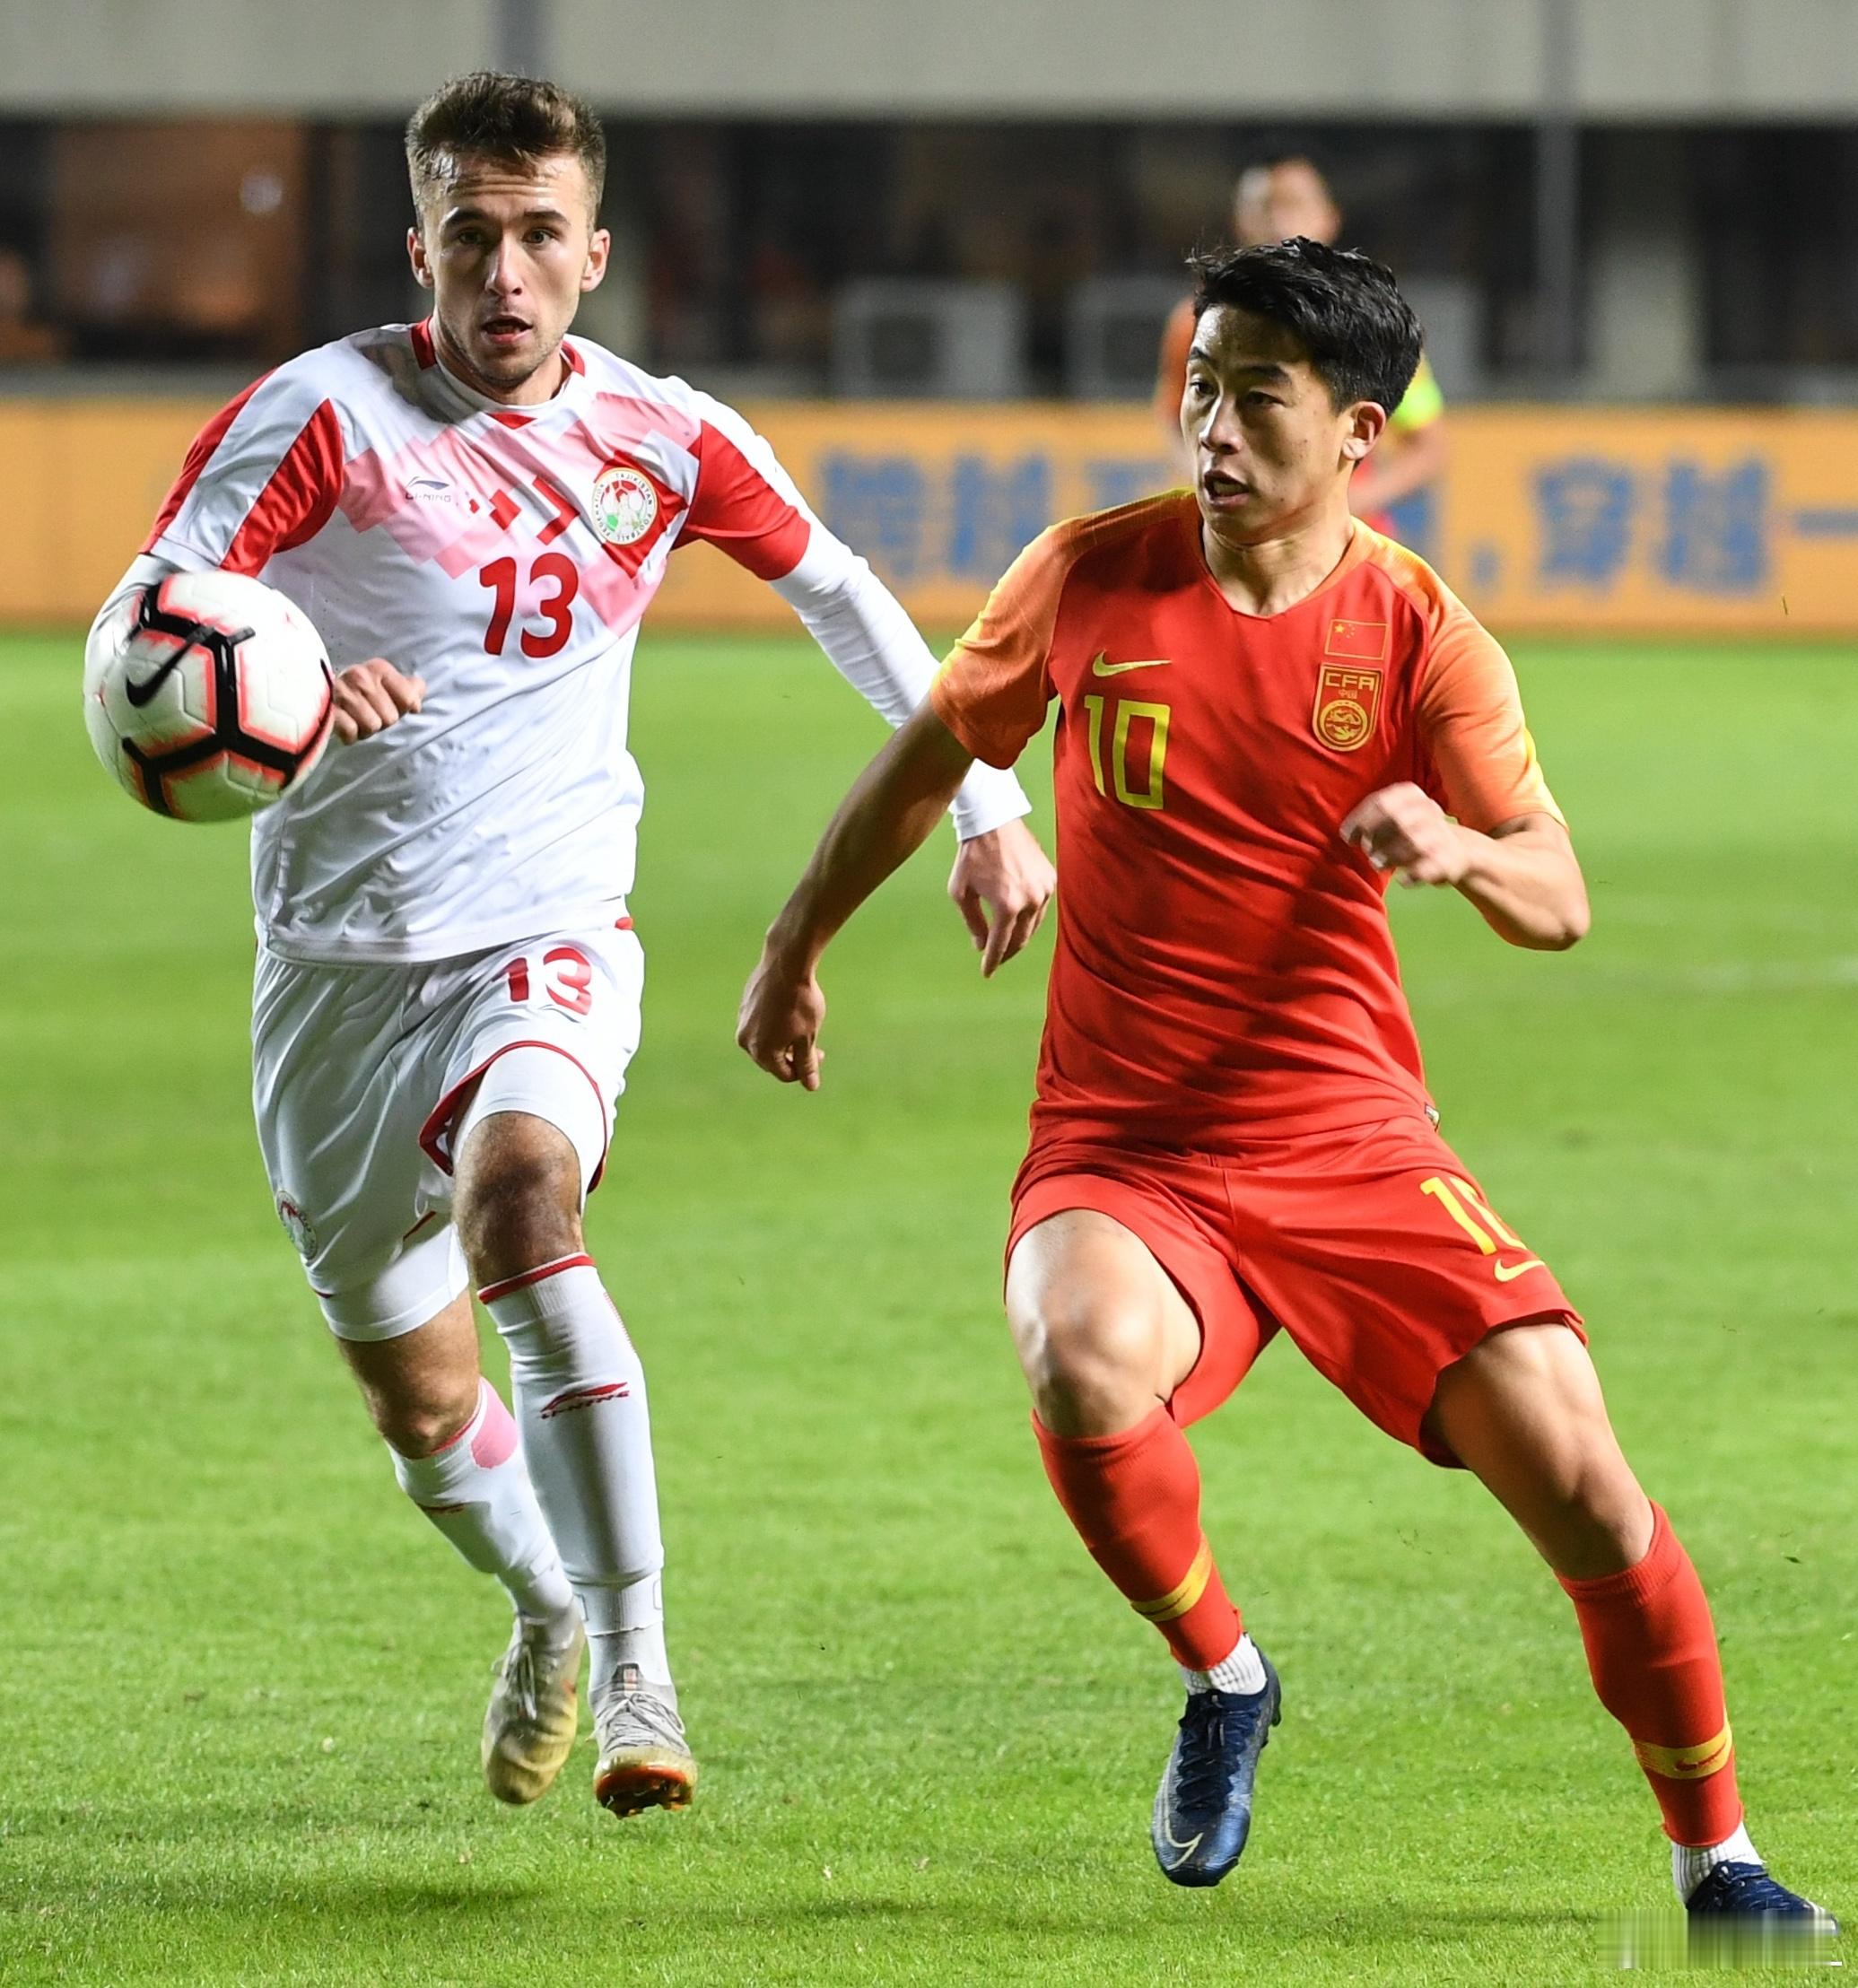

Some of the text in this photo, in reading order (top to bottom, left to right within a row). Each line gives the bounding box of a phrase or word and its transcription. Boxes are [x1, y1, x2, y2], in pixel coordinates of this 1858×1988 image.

[478, 551, 580, 659] 13
[1324, 672, 1376, 692] CFA
[1083, 693, 1172, 811] 10
[493, 946, 593, 1016] 13
